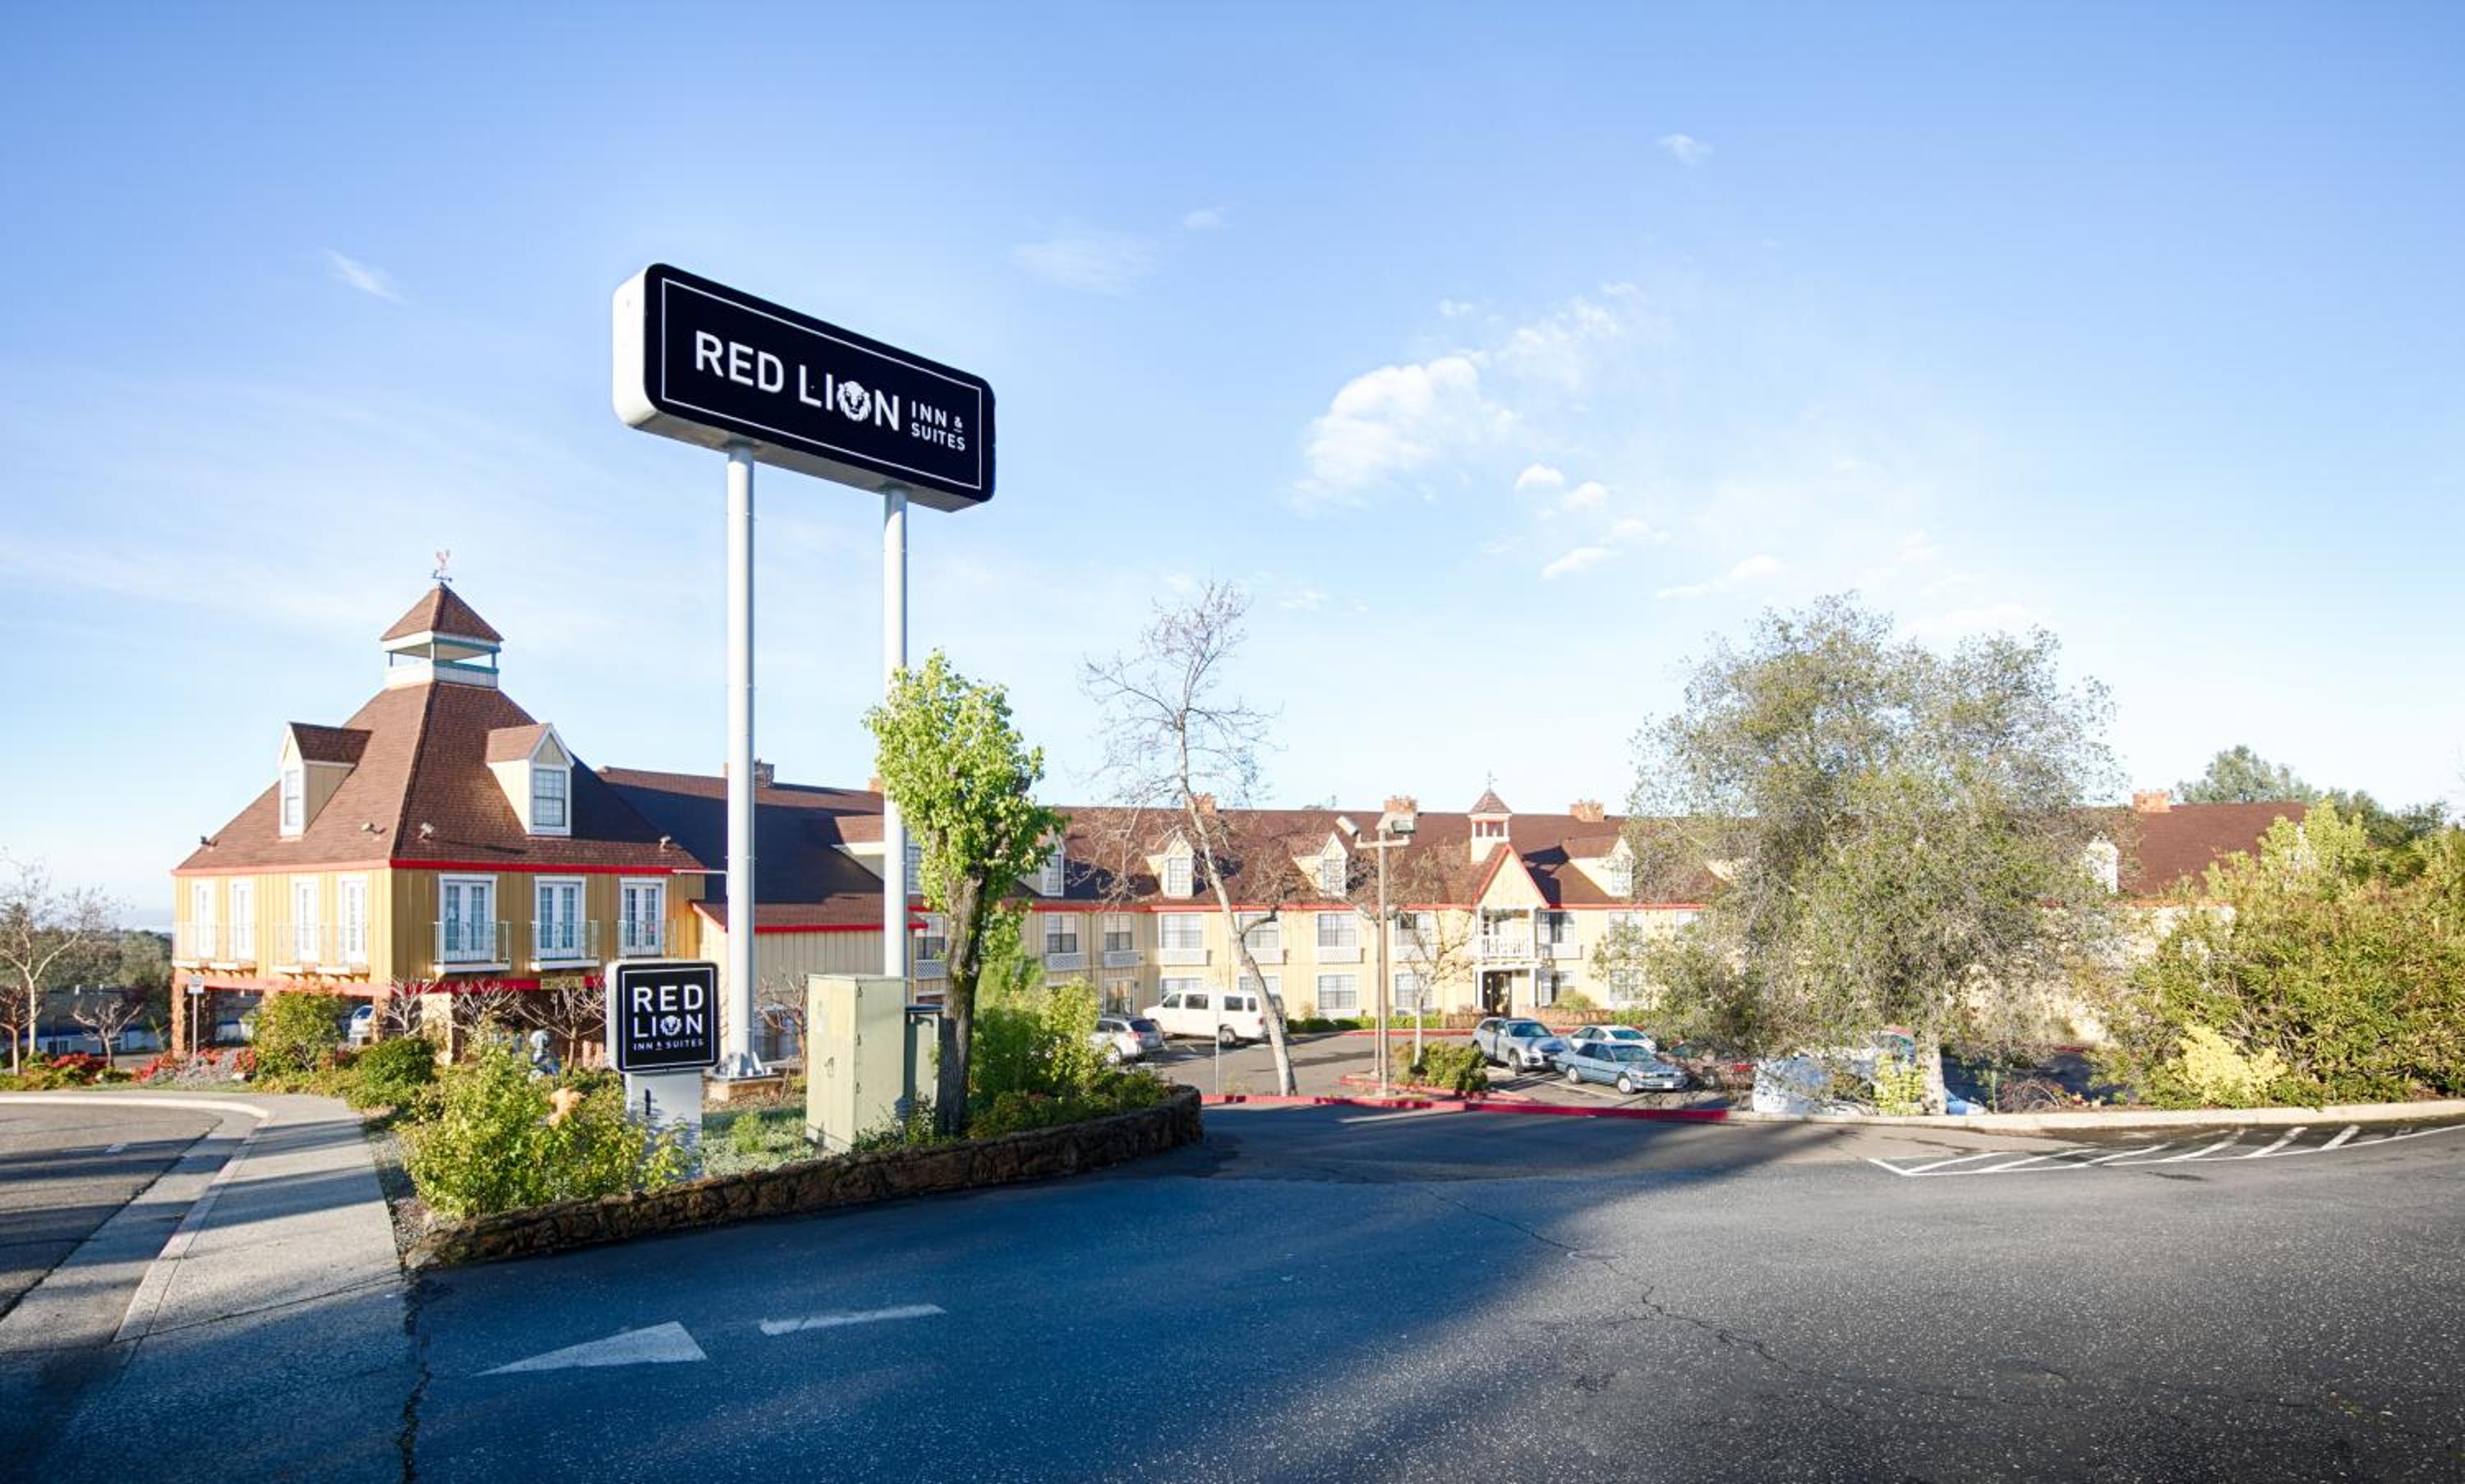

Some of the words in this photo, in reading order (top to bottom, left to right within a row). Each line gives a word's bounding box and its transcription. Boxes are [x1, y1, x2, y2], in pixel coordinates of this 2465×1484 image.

[696, 330, 784, 393] RED
[799, 364, 900, 431] LION
[911, 400, 947, 428] INN
[954, 416, 963, 433] &
[911, 422, 965, 451] SUITES
[633, 984, 704, 1013] RED
[634, 1013, 703, 1038] LION
[633, 1043, 653, 1051] INN
[666, 1039, 704, 1049] SUITES
